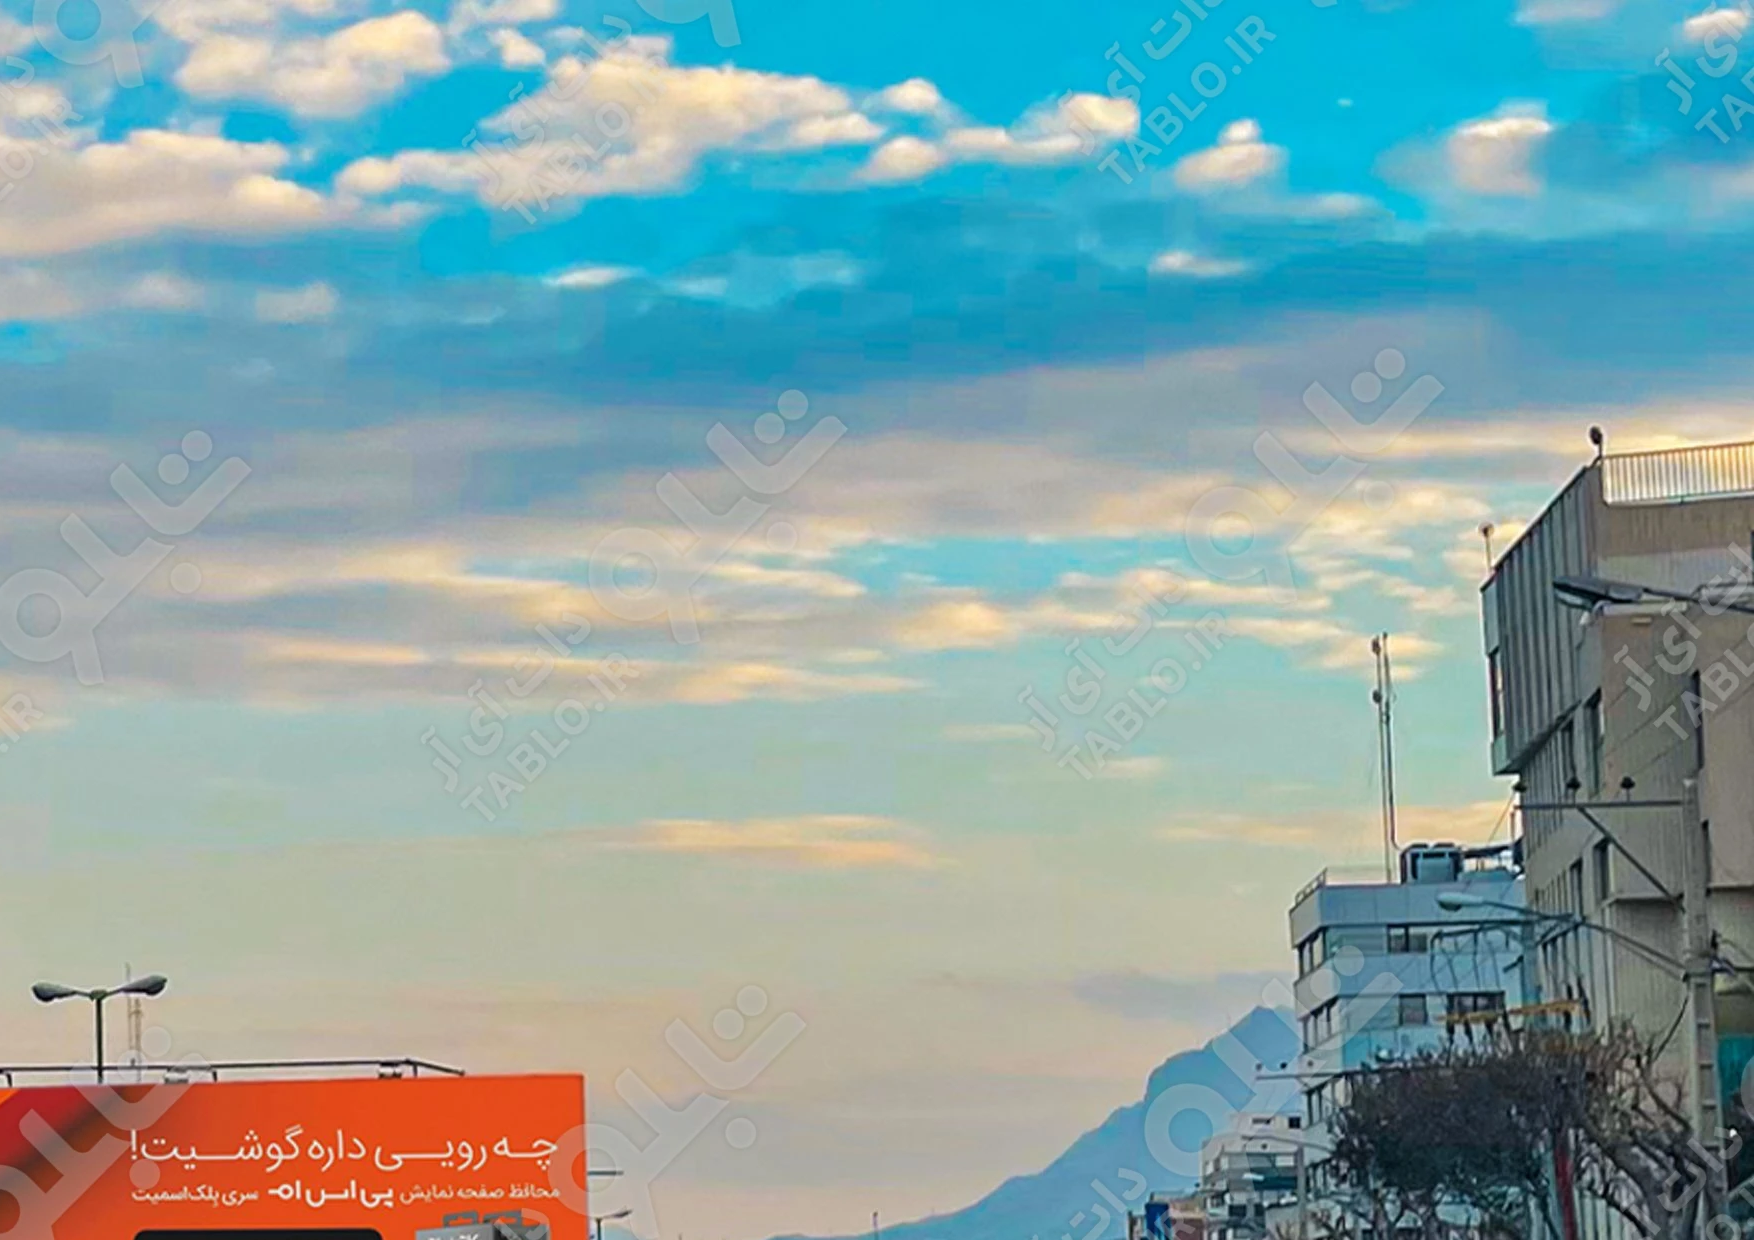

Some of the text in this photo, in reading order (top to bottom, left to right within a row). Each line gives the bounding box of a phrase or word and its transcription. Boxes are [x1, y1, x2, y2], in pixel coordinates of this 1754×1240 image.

[307, 1128, 367, 1173] داره
[374, 1140, 488, 1172] رویی
[493, 1136, 559, 1171] چه
[399, 1183, 455, 1205] نمایش
[456, 1184, 505, 1200] صفحه
[508, 1183, 561, 1199] محافظ
